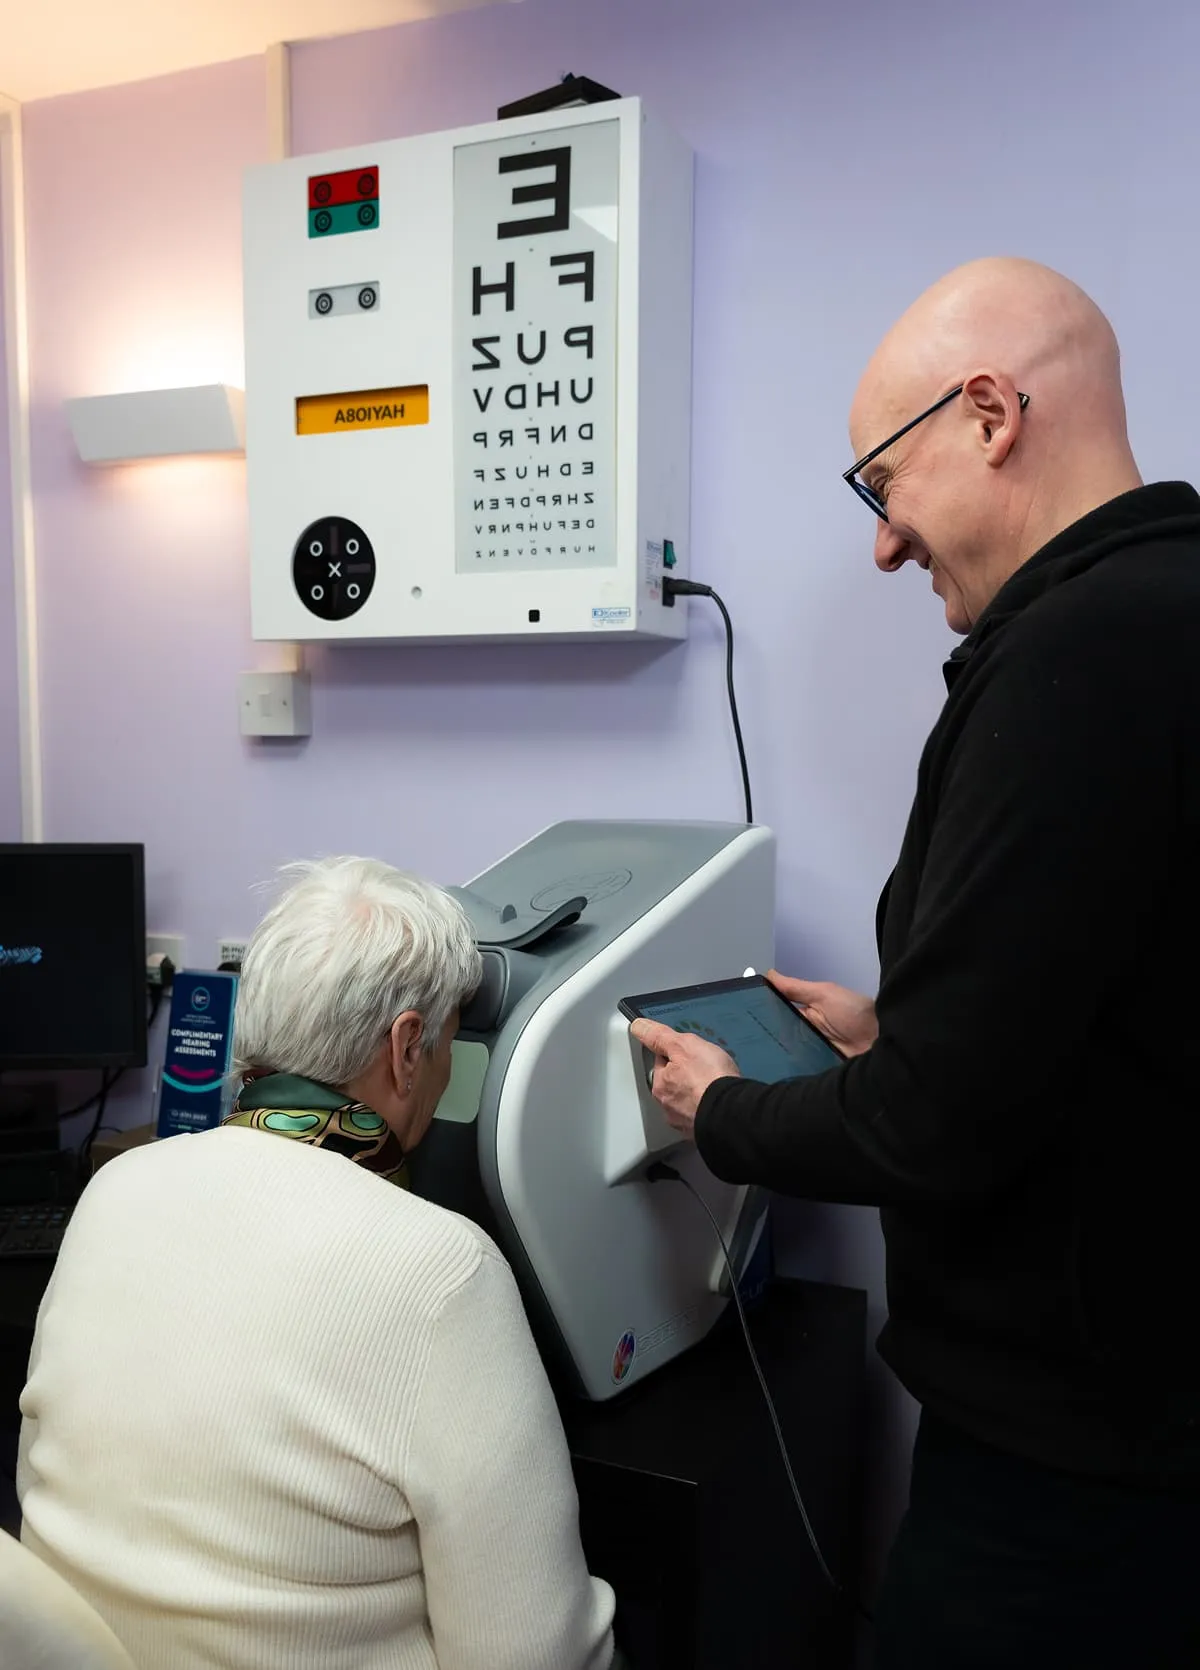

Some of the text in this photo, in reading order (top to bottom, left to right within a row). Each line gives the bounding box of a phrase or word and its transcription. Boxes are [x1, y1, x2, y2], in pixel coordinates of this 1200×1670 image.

[171, 1028, 223, 1041] COMPLIMENTARY
[182, 1039, 211, 1049] HEARING
[174, 1046, 217, 1058] ASSESSMENTS
